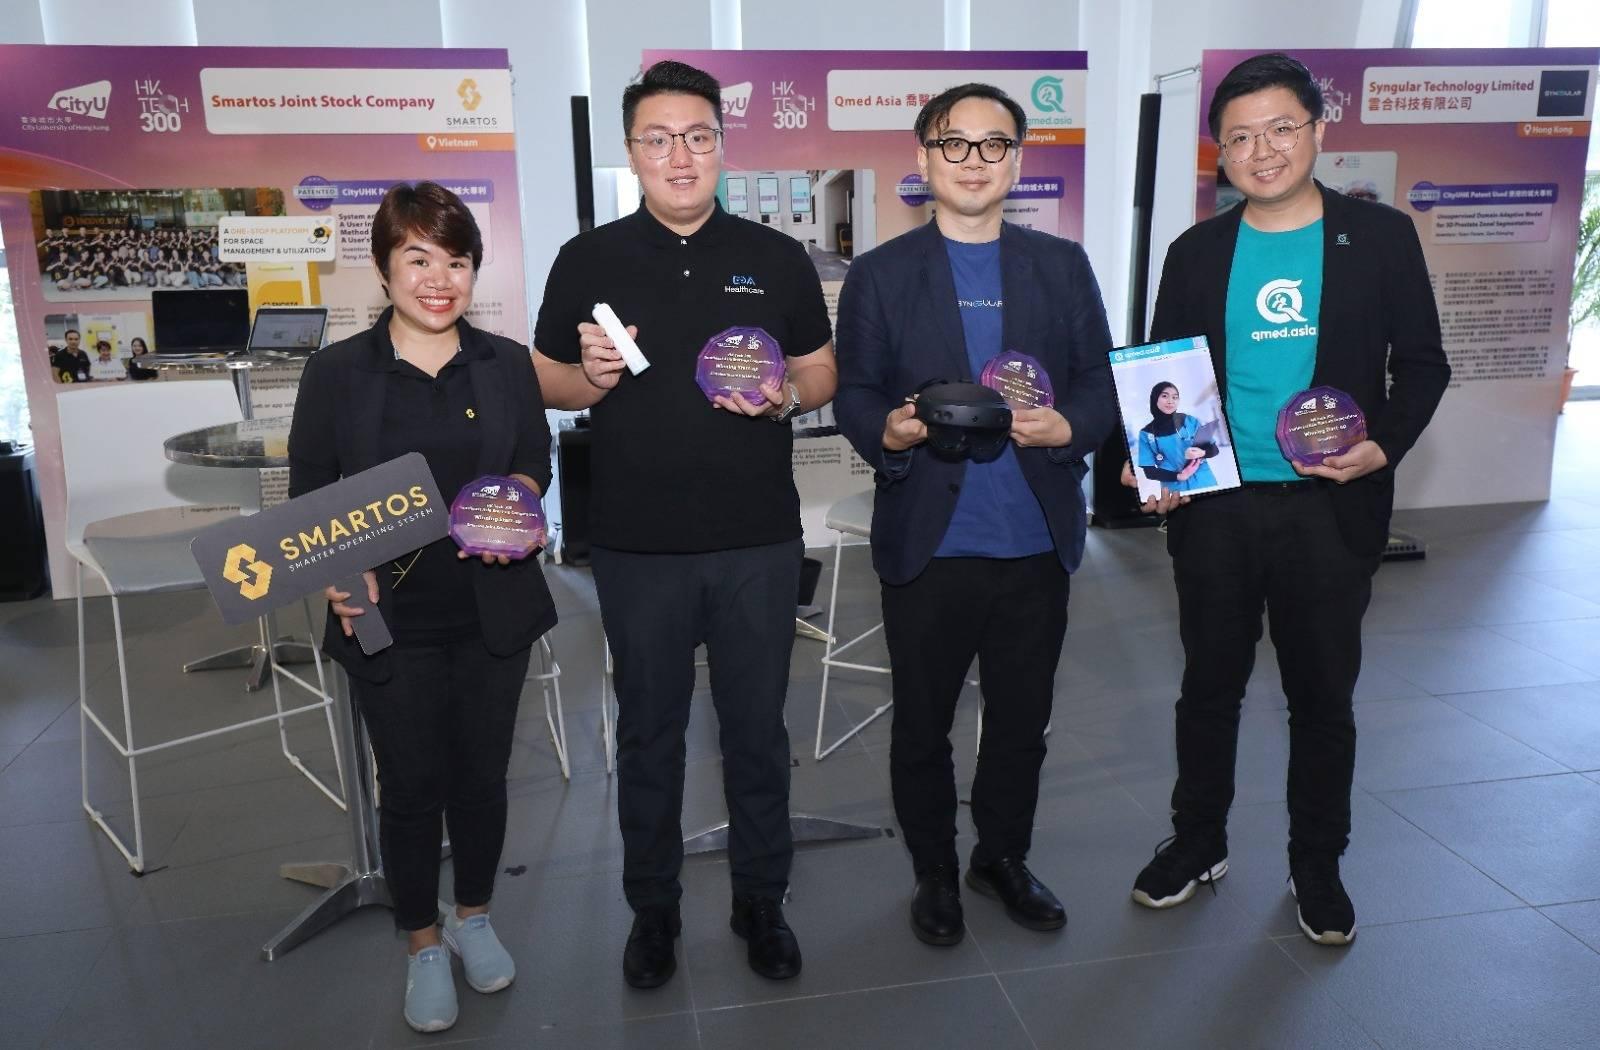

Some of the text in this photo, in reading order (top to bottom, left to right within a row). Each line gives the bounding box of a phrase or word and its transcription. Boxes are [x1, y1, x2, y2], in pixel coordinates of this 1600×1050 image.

[135, 80, 163, 95] HK
[772, 81, 794, 95] HK
[1369, 79, 1535, 95] Syngular Technology Limited
[55, 96, 106, 115] CityU
[211, 95, 435, 110] Smartos Joint Stock Company
[834, 95, 902, 107] Qmed Asia
[140, 113, 181, 132] 300
[446, 117, 498, 126] SMARTOS
[772, 111, 807, 129] 300
[1532, 125, 1552, 135] Hong
[438, 137, 478, 147] Vietnam
[1026, 132, 1056, 143] alaysia
[297, 188, 336, 196] PATENTED
[342, 188, 378, 198] CityUHK
[338, 213, 366, 221] System
[724, 285, 765, 295] Healthcare
[1251, 325, 1317, 341] qmed.asia
[279, 485, 428, 561] SMARTOS
[288, 507, 434, 573] SMARTER OPERATING SYSTEM
